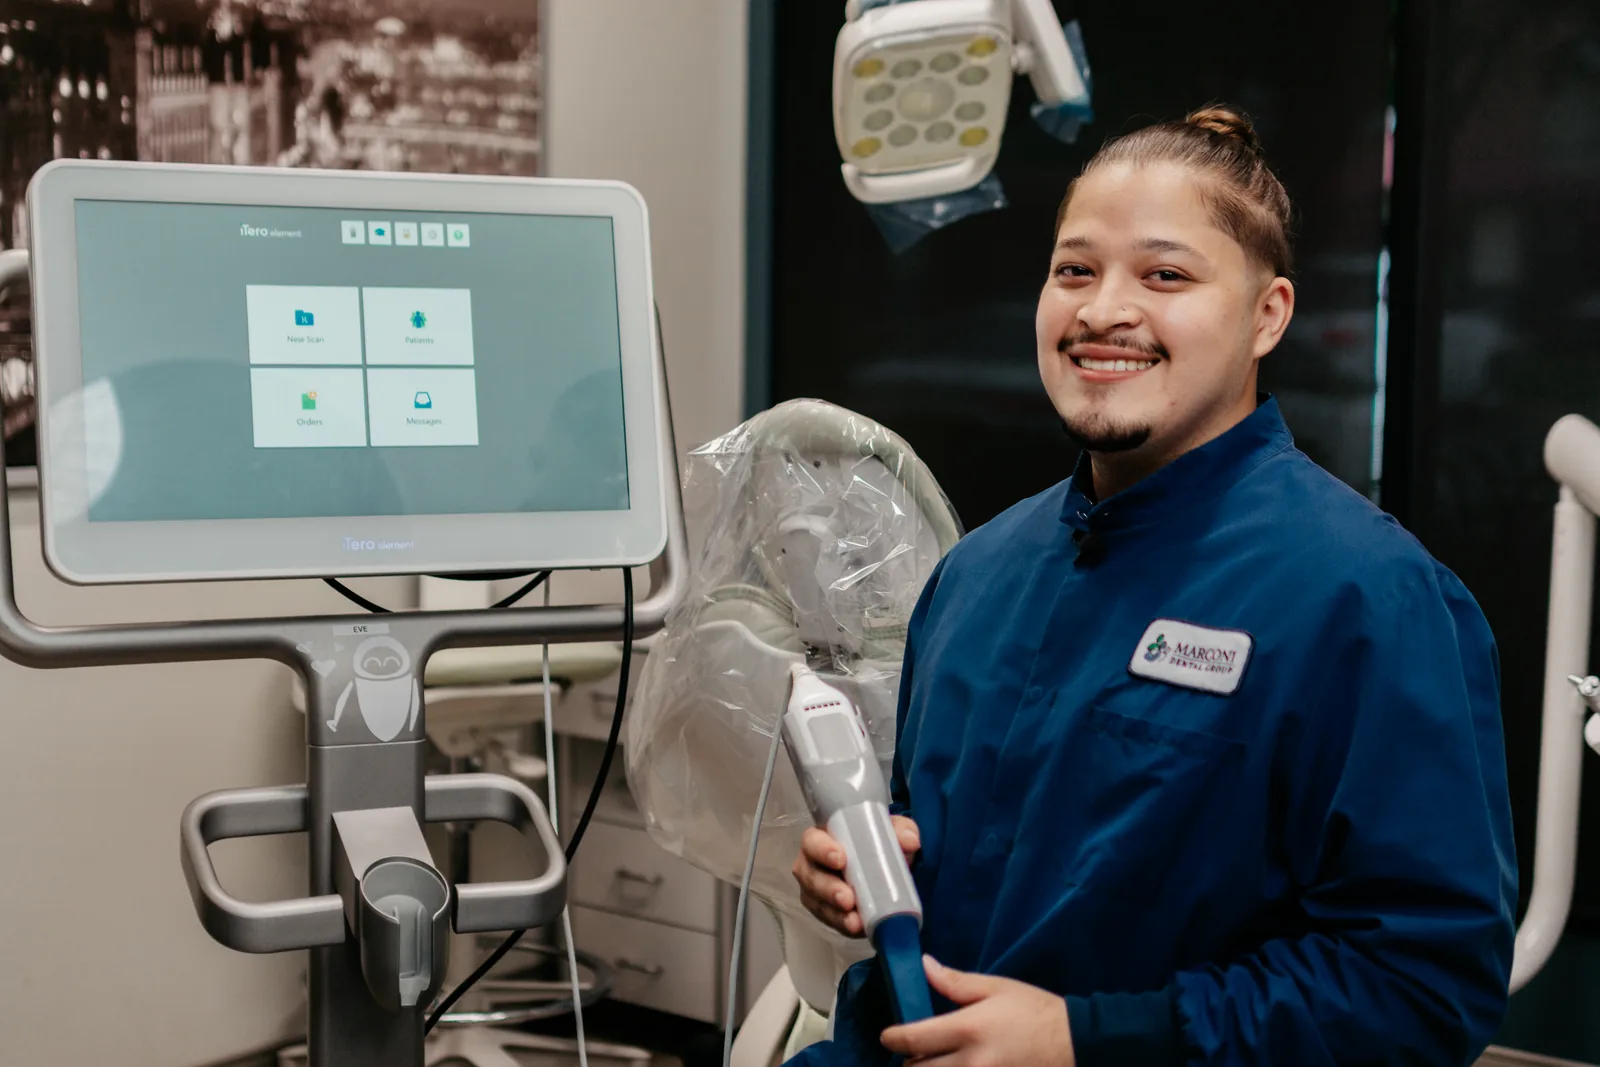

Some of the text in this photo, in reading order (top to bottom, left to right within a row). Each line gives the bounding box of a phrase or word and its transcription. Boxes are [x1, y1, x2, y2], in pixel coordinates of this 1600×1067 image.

[287, 335, 325, 344] New Scan
[405, 336, 435, 345] Patients
[296, 417, 323, 426] Orders
[406, 417, 442, 427] Messages
[353, 625, 368, 633] EVE
[1174, 642, 1236, 662] MARCONI
[1169, 657, 1233, 674] DENTAL GROUP
